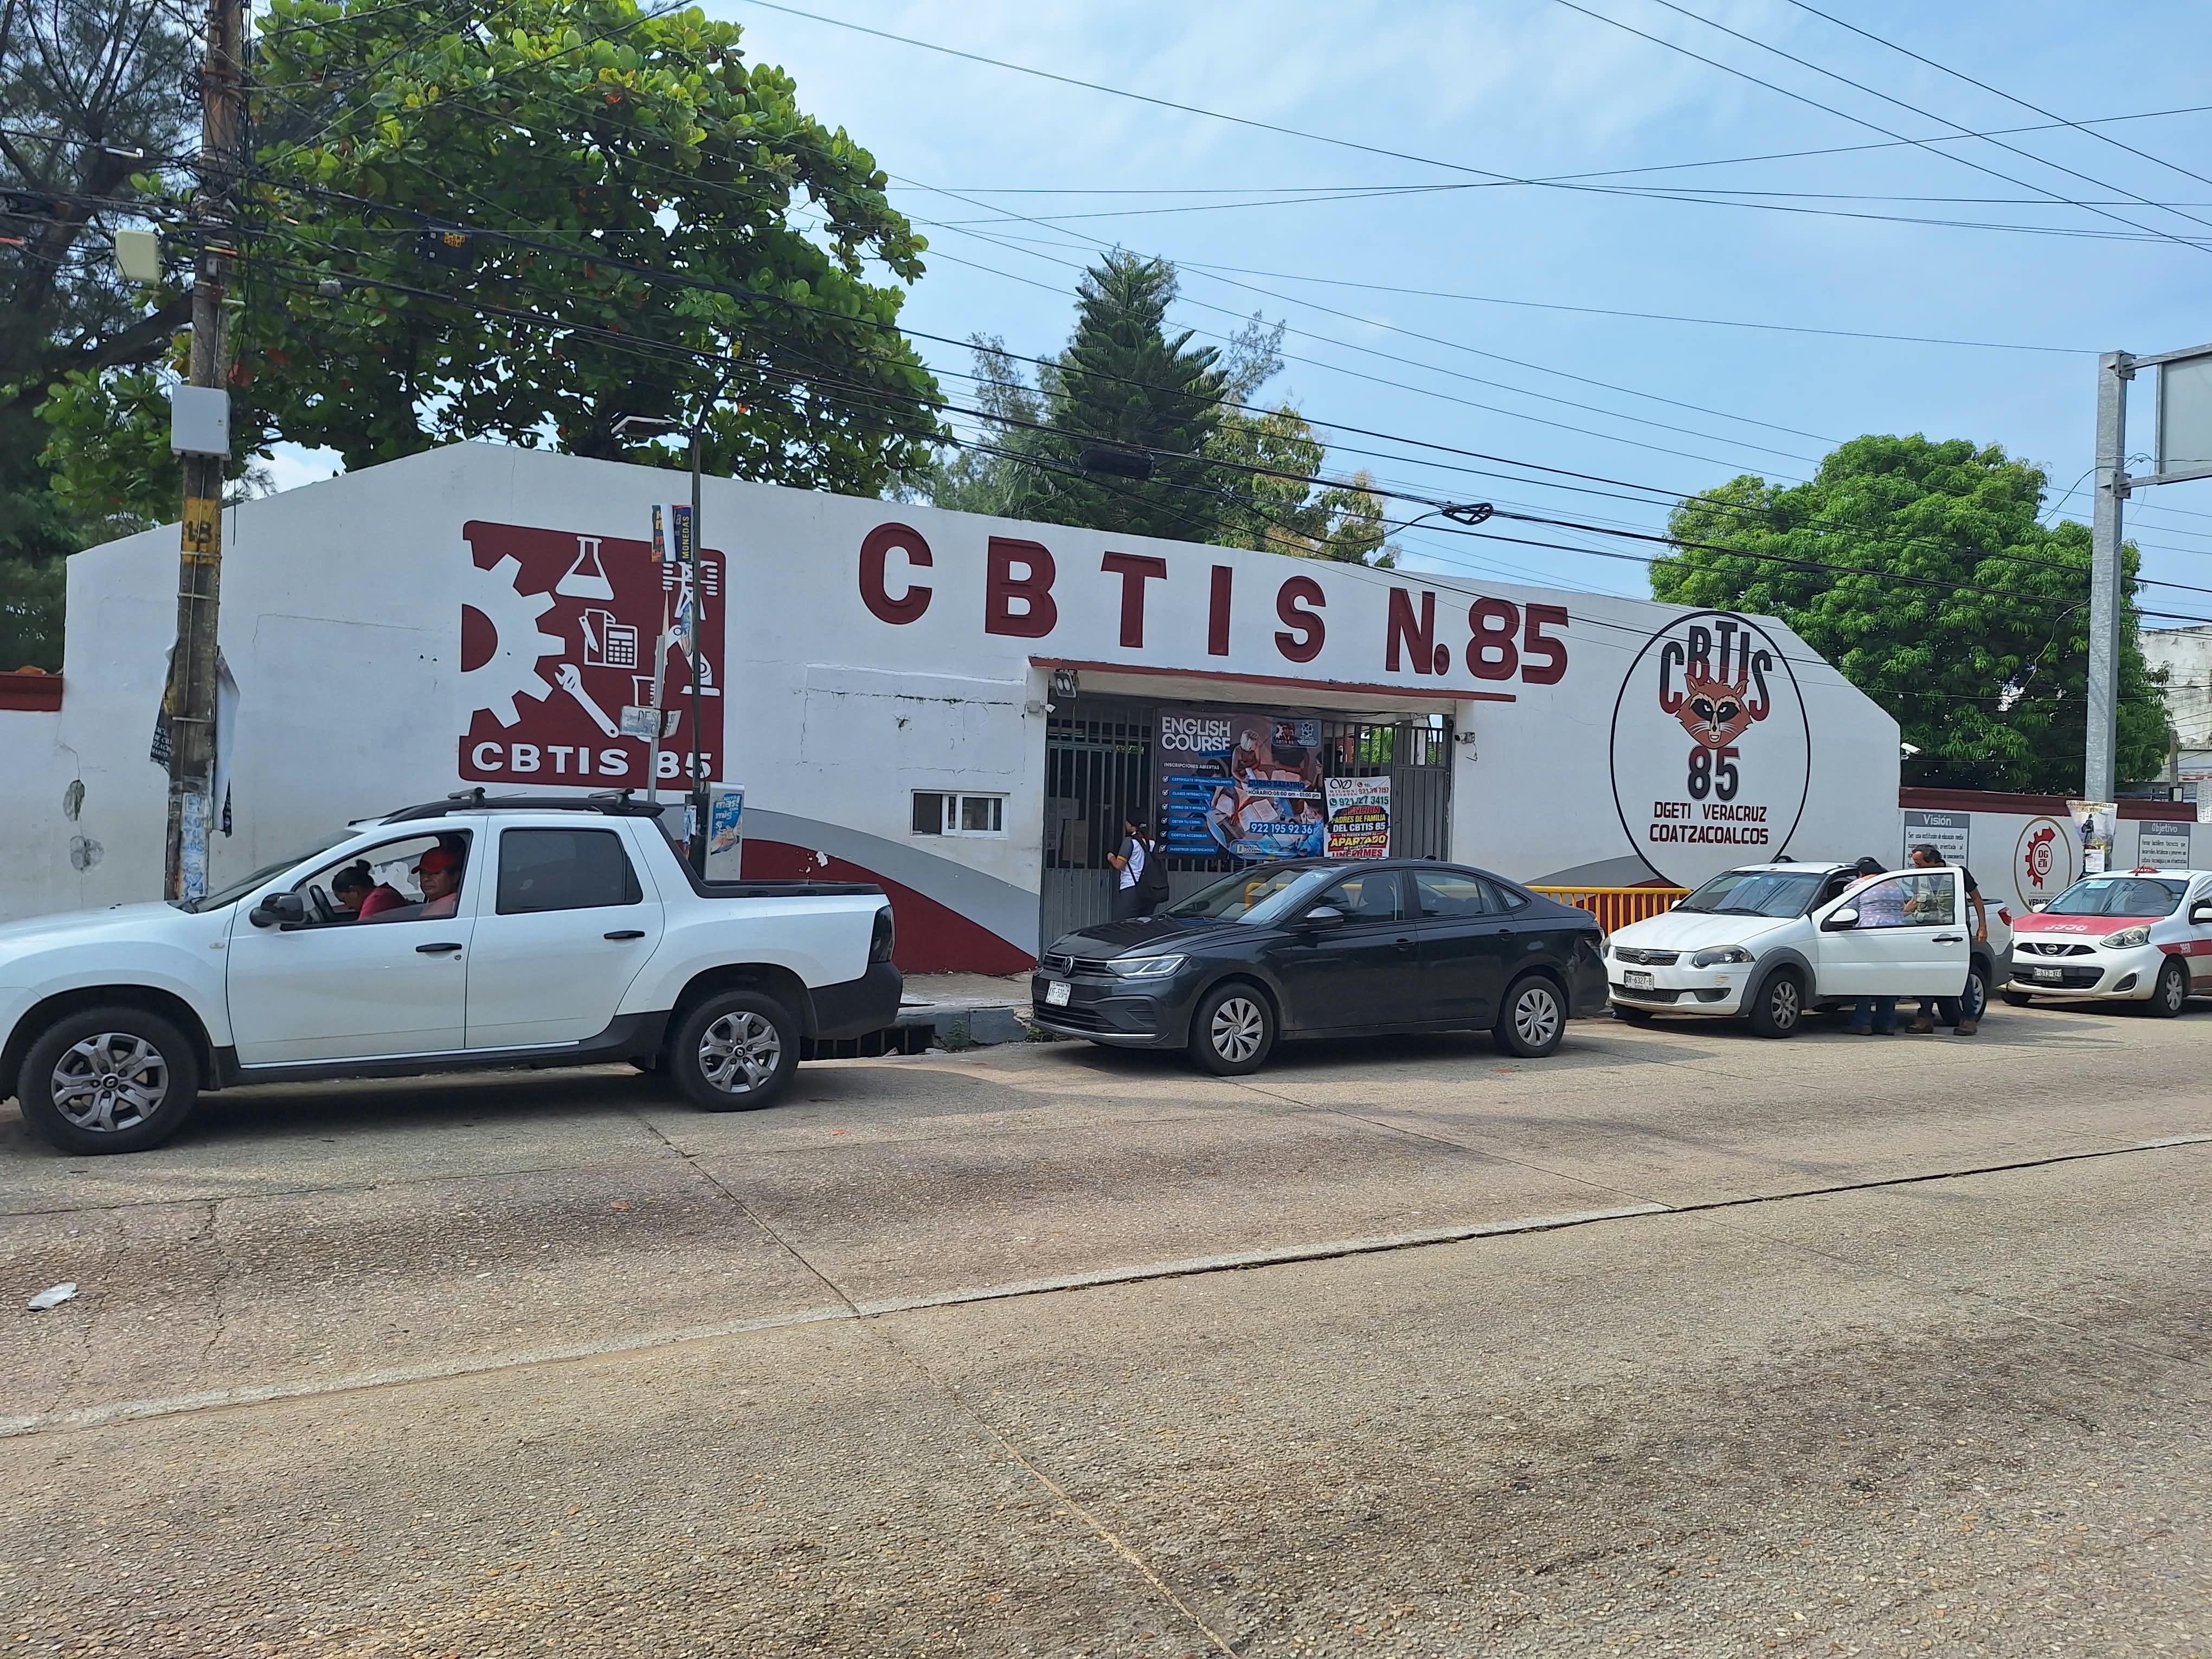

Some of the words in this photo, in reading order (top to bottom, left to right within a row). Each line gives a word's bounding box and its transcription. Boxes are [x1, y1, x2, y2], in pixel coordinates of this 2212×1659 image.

[681, 516, 690, 559] MONEDAS
[859, 522, 1327, 664] CBTIS
[1659, 620, 1773, 722] CBTIS
[1162, 716, 1231, 737] ENGLISH
[1161, 733, 1231, 751] COURSE
[472, 741, 629, 776] CBTIS
[657, 751, 712, 779] 85
[1688, 745, 1740, 802] 85
[1339, 798, 1354, 806] 921
[1370, 796, 1389, 805] 3415
[1364, 814, 1386, 822] FAMILIA
[1654, 801, 1692, 819] DGETI
[1702, 803, 1767, 822] VERACRUZ
[1333, 824, 1348, 833] DEL
[1349, 822, 1374, 832] CBTIS
[1375, 822, 1386, 831] 85
[1922, 814, 1952, 826] Visión
[1251, 823, 1269, 833] 922
[1271, 824, 1286, 833] 195
[1288, 824, 1300, 833] 92
[1301, 825, 1313, 834] 36
[1650, 824, 1769, 845] COATZACOALCOS
[2152, 822, 2178, 834] Objetivo
[1330, 835, 1386, 847] APARTADO
[2038, 850, 2049, 858] DG
[2038, 859, 2047, 867] ETI
